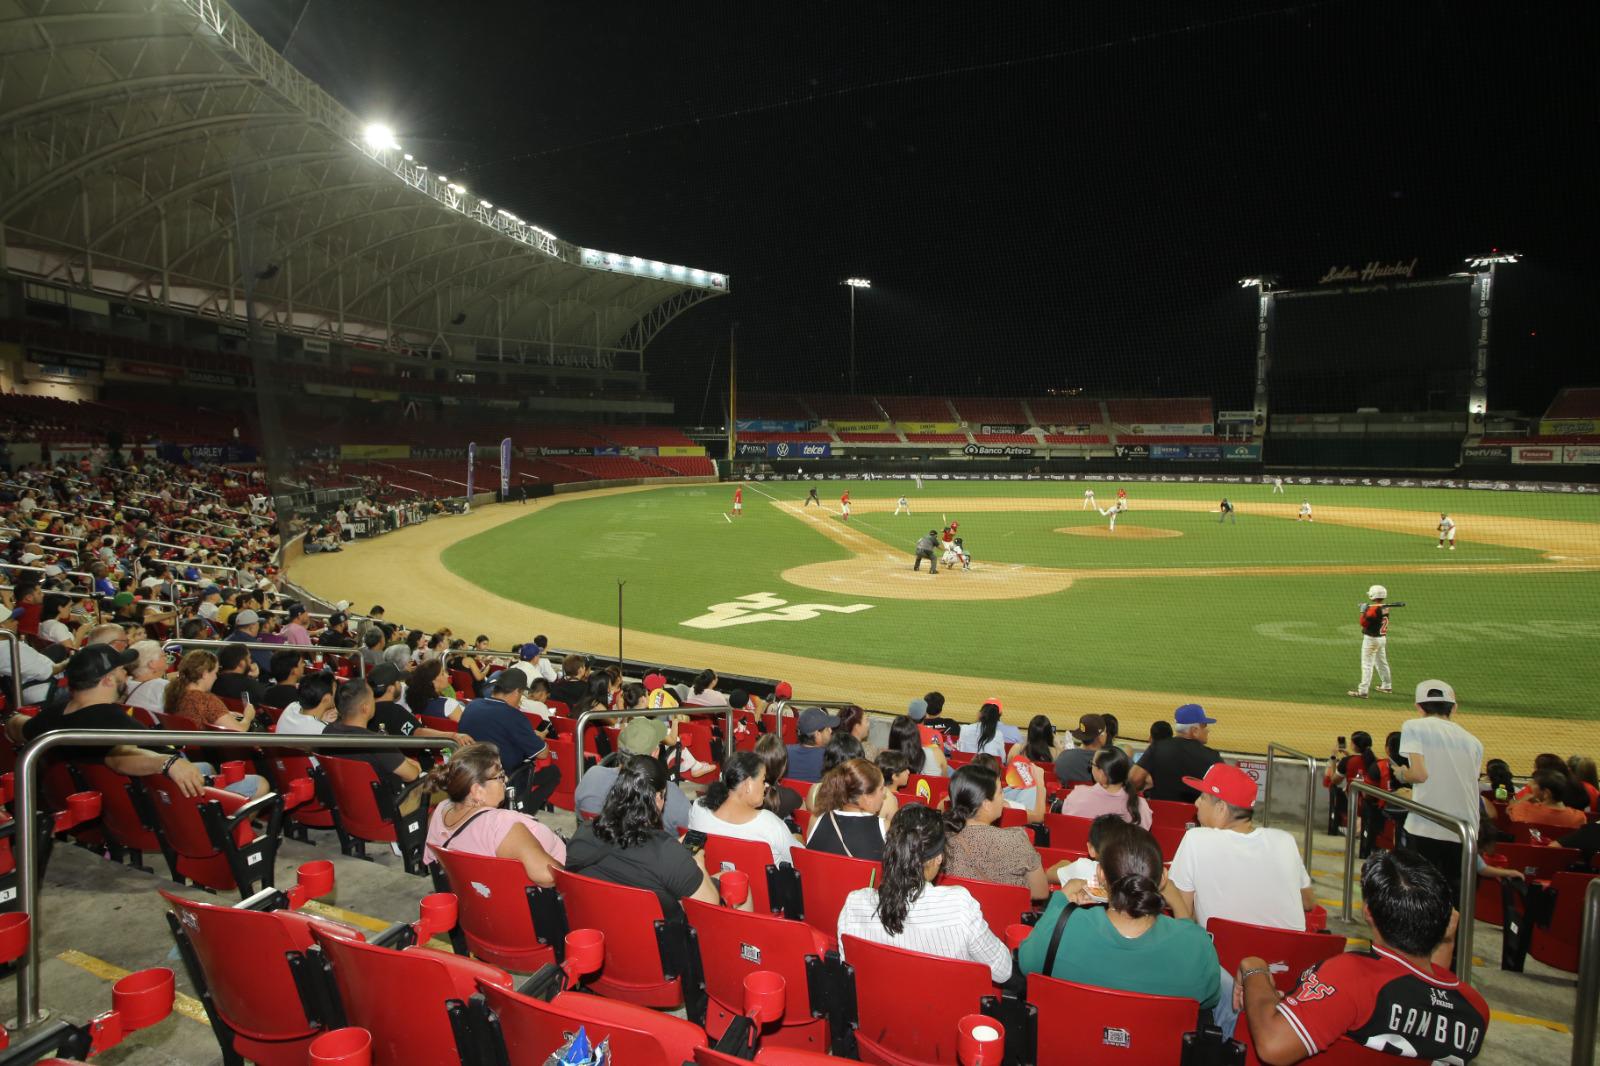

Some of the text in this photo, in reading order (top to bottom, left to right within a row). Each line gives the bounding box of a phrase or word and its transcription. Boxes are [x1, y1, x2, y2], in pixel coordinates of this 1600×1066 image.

[1360, 257, 1418, 282] Huichol
[192, 447, 223, 456] GARLEY
[803, 445, 825, 455] telcel
[1004, 447, 1031, 455] Azteca
[1388, 1003, 1479, 1053] GAMBOA
